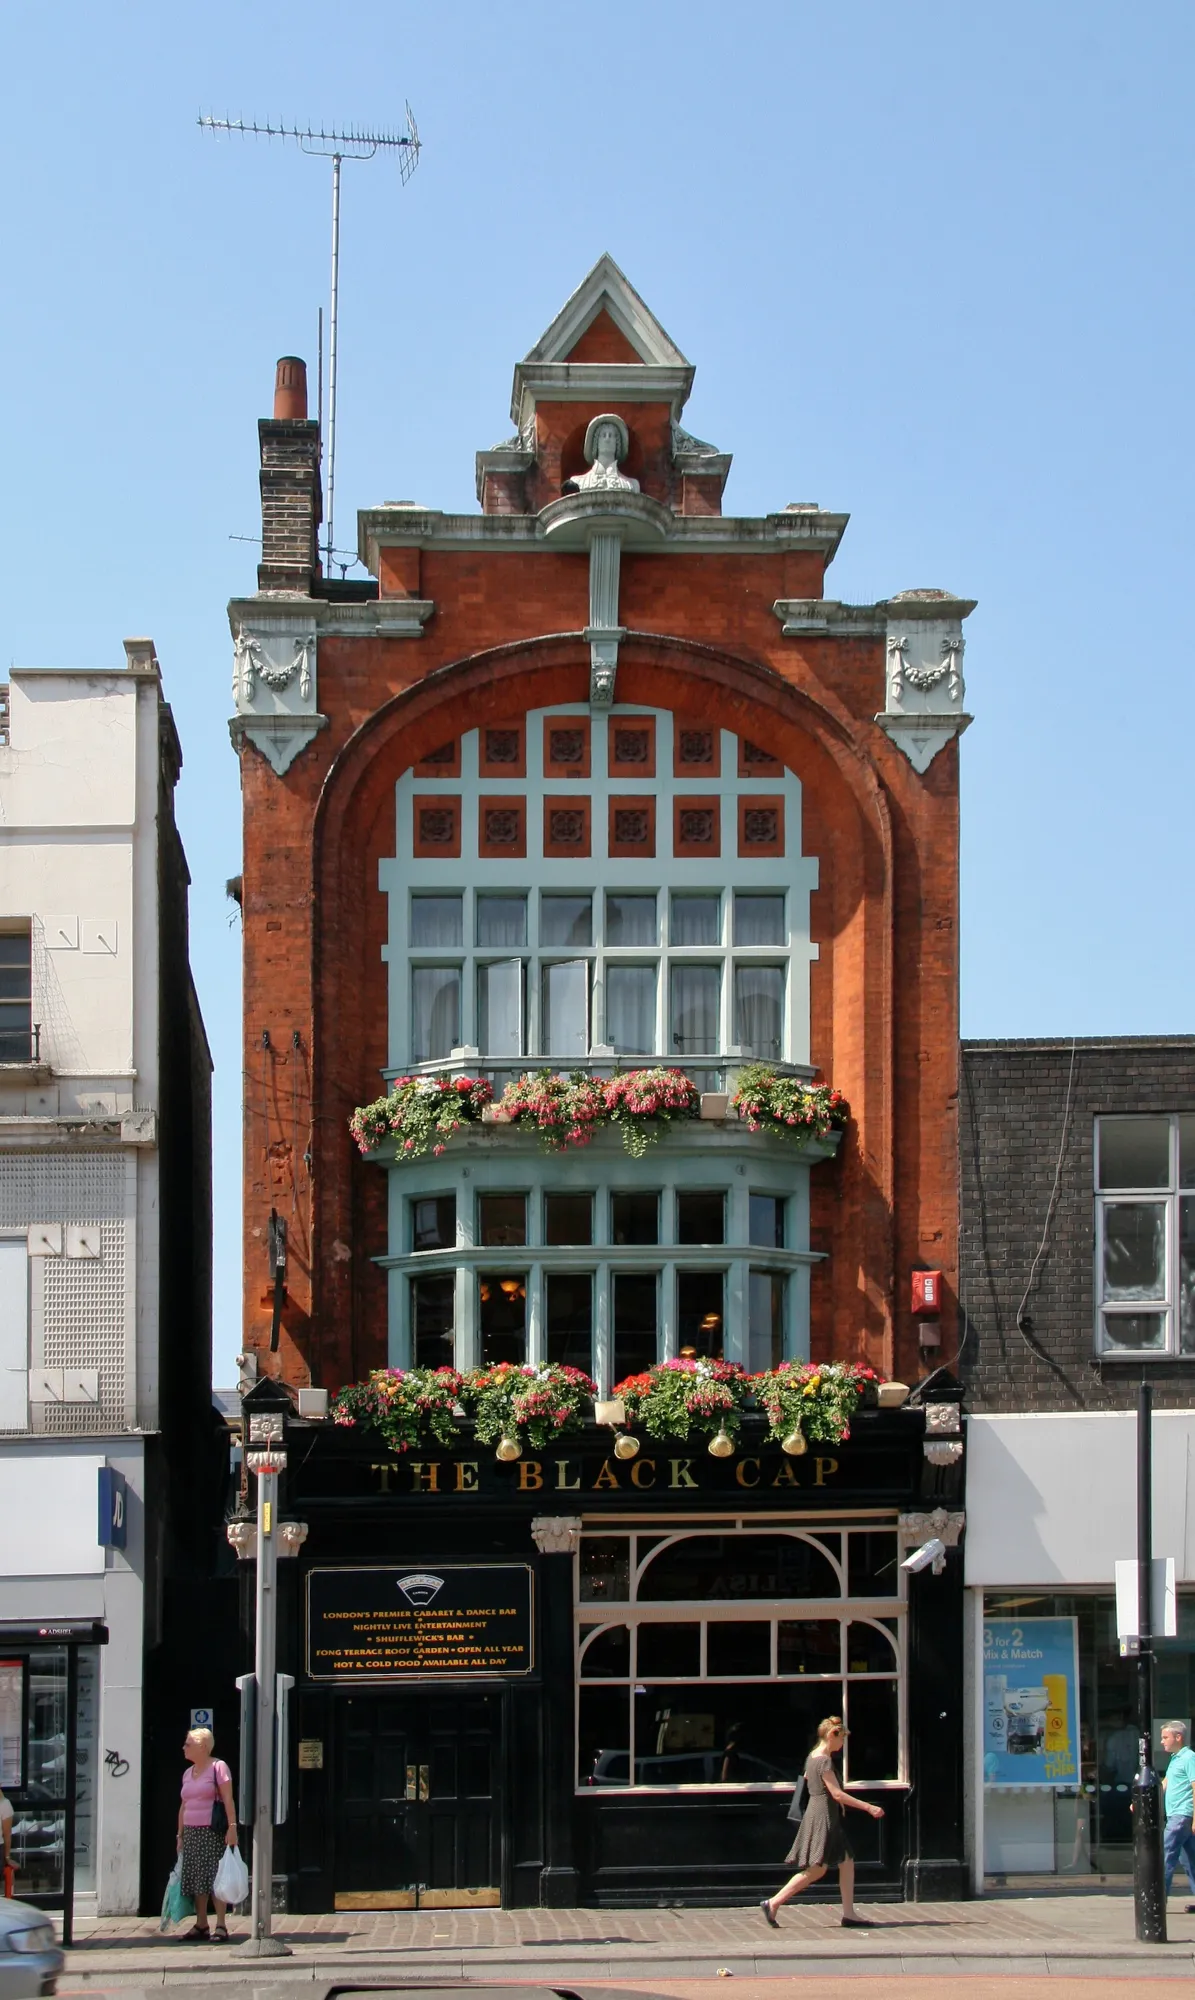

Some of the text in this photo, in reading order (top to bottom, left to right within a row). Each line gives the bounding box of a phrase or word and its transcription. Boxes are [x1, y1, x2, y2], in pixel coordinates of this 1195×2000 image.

[371, 1456, 840, 1492] THE BLACK CAP
[112, 1491, 124, 1528] JD
[400, 1578, 441, 1588] BLACK CAP
[323, 1611, 371, 1619] LONDON'S
[353, 1623, 392, 1631] NIGHTLY
[414, 1621, 487, 1629] ENTERTAINMENT
[375, 1635, 444, 1643] SHUFFLEWICK'S
[983, 1628, 1024, 1647] 3 for 2
[343, 1648, 383, 1656] TERRACE
[983, 1649, 1043, 1660] Mix & Match
[1045, 1751, 1072, 1764] OUT
